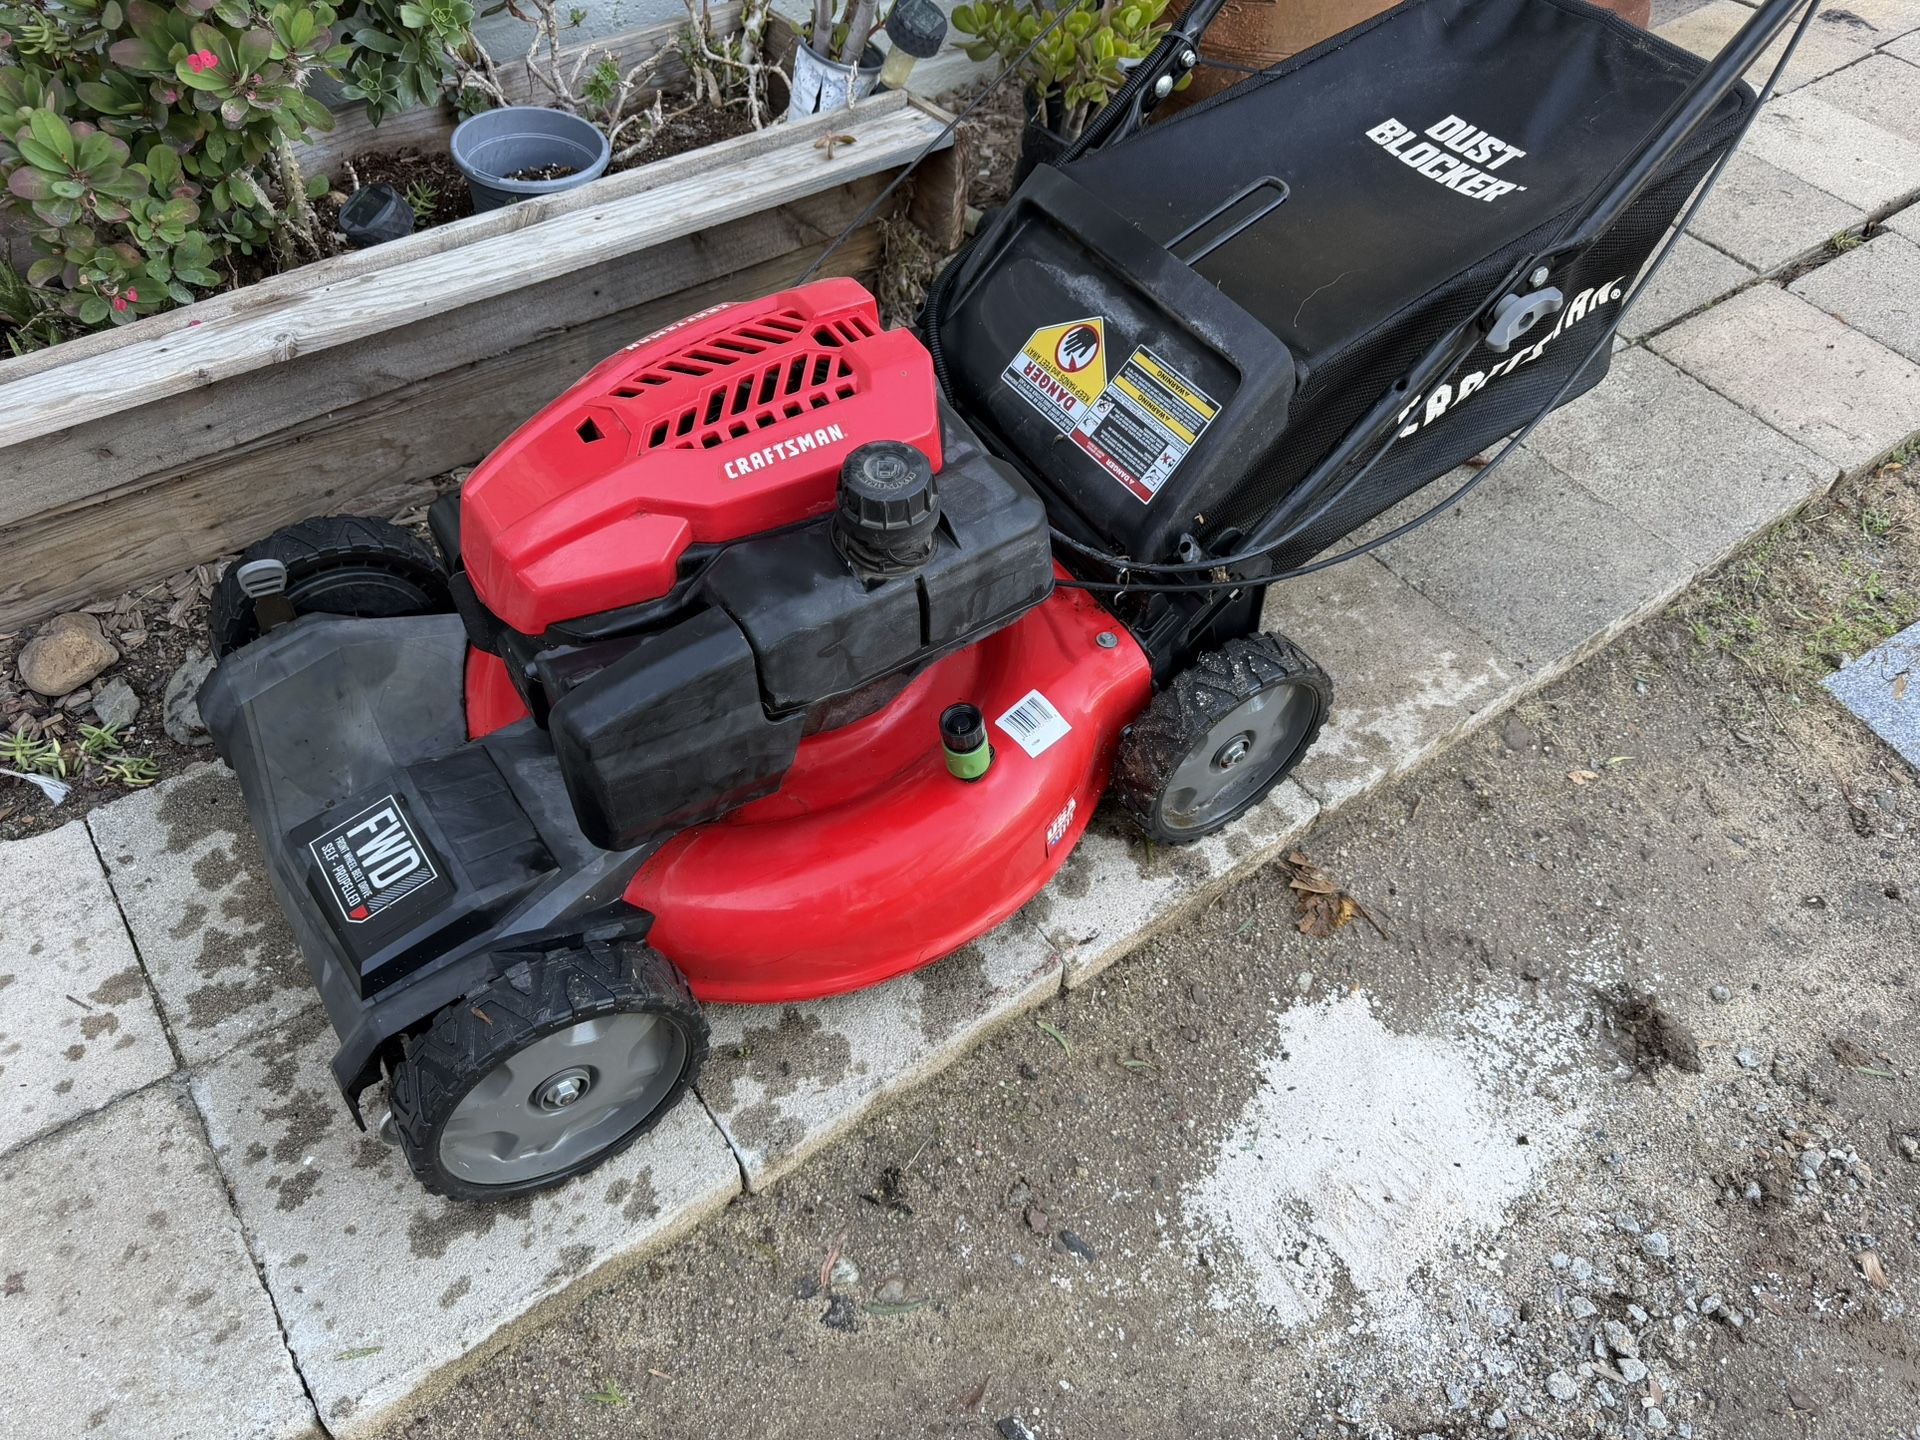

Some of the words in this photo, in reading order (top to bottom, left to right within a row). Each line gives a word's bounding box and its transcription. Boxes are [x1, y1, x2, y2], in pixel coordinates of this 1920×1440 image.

[1365, 117, 1519, 202] BLOCKER
[1424, 114, 1526, 171] DUST
[1025, 346, 1042, 361] AWAY
[1038, 357, 1053, 370] FEET
[1020, 360, 1078, 411] DANGER
[1057, 374, 1078, 392] HANDS
[1073, 388, 1091, 403] KEEP
[1155, 369, 1186, 395] WARNING
[1136, 393, 1166, 419] WARNING
[723, 424, 845, 479] CRAFTSMAN
[1104, 458, 1130, 482] DANGER
[334, 836, 350, 854] FRONT
[343, 851, 358, 871] WHEEL
[351, 868, 365, 882] BELT
[358, 880, 372, 898] DRIVE
[346, 807, 420, 889] FWD
[322, 842, 339, 862] SELF
[332, 864, 361, 907] PROPELLED
